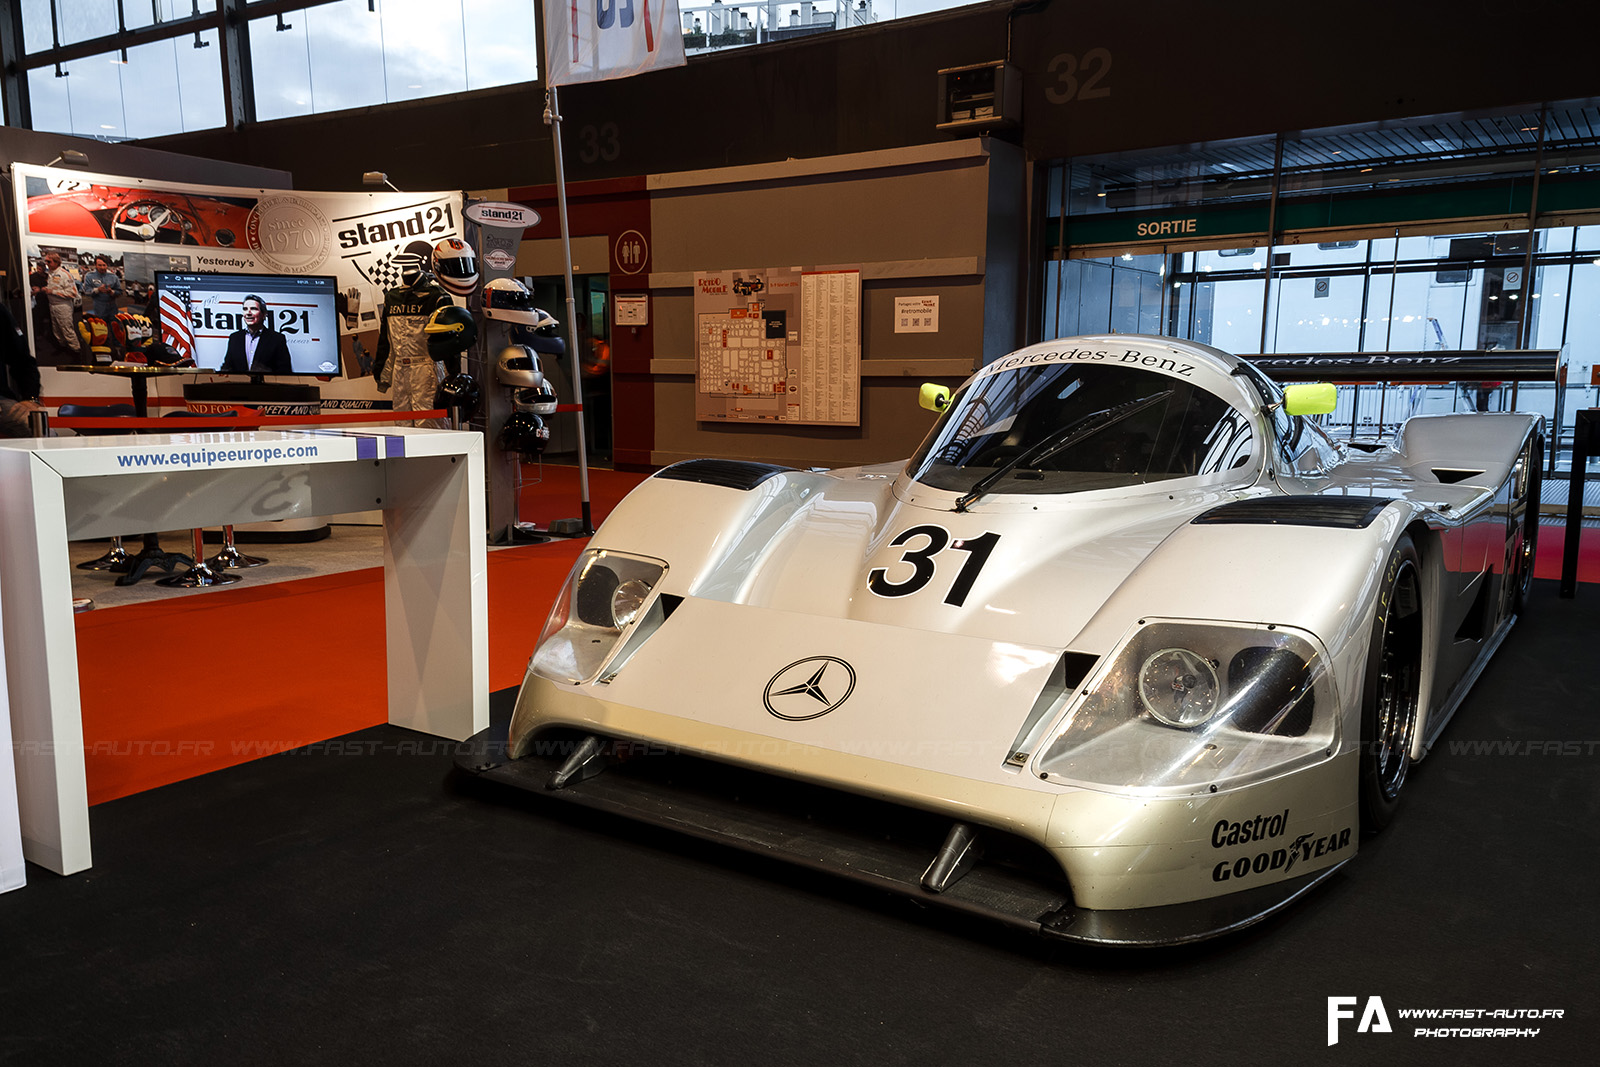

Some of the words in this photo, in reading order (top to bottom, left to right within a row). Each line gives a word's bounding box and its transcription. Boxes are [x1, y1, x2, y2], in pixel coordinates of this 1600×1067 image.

[1044, 48, 1112, 104] 32
[579, 121, 621, 164] 33
[268, 217, 305, 231] since
[338, 203, 455, 249] stand21
[481, 209, 524, 221] stand21
[1137, 218, 1197, 237] SORTIE
[267, 228, 316, 252] 1970
[196, 256, 255, 269] Yesterday's
[389, 304, 423, 315] BENTLEY
[984, 348, 1196, 377] Mercedes-Benz
[291, 405, 309, 415] AND
[321, 400, 338, 408] AND
[117, 444, 318, 468] www.equipeeurope.com
[867, 524, 1002, 608] 31
[1211, 809, 1290, 849] Castrol
